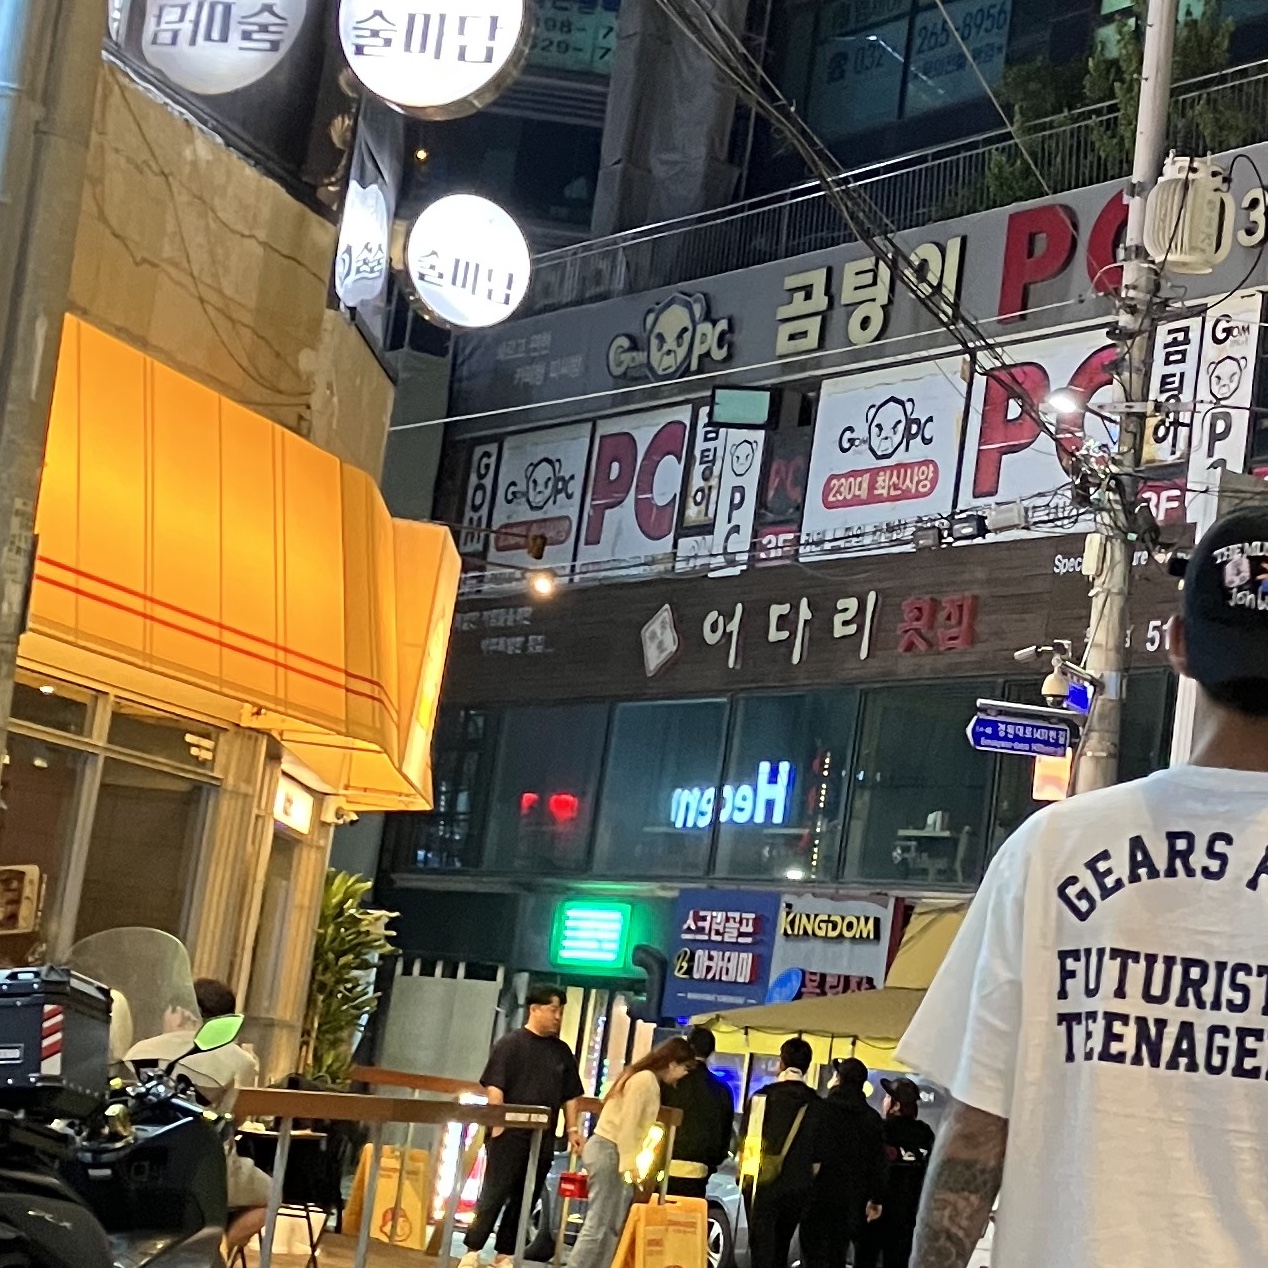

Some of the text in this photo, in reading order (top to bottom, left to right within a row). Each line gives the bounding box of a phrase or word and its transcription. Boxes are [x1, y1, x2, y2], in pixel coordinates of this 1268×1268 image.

[584, 432, 686, 546] PC
[828, 464, 934, 501] 230대 최신사양
[702, 590, 879, 669] 어다리
[1057, 830, 1234, 922] GEARS
[681, 910, 756, 944] 스크린골프
[780, 911, 875, 939] KINGDOM
[692, 949, 753, 983] 아카데미
